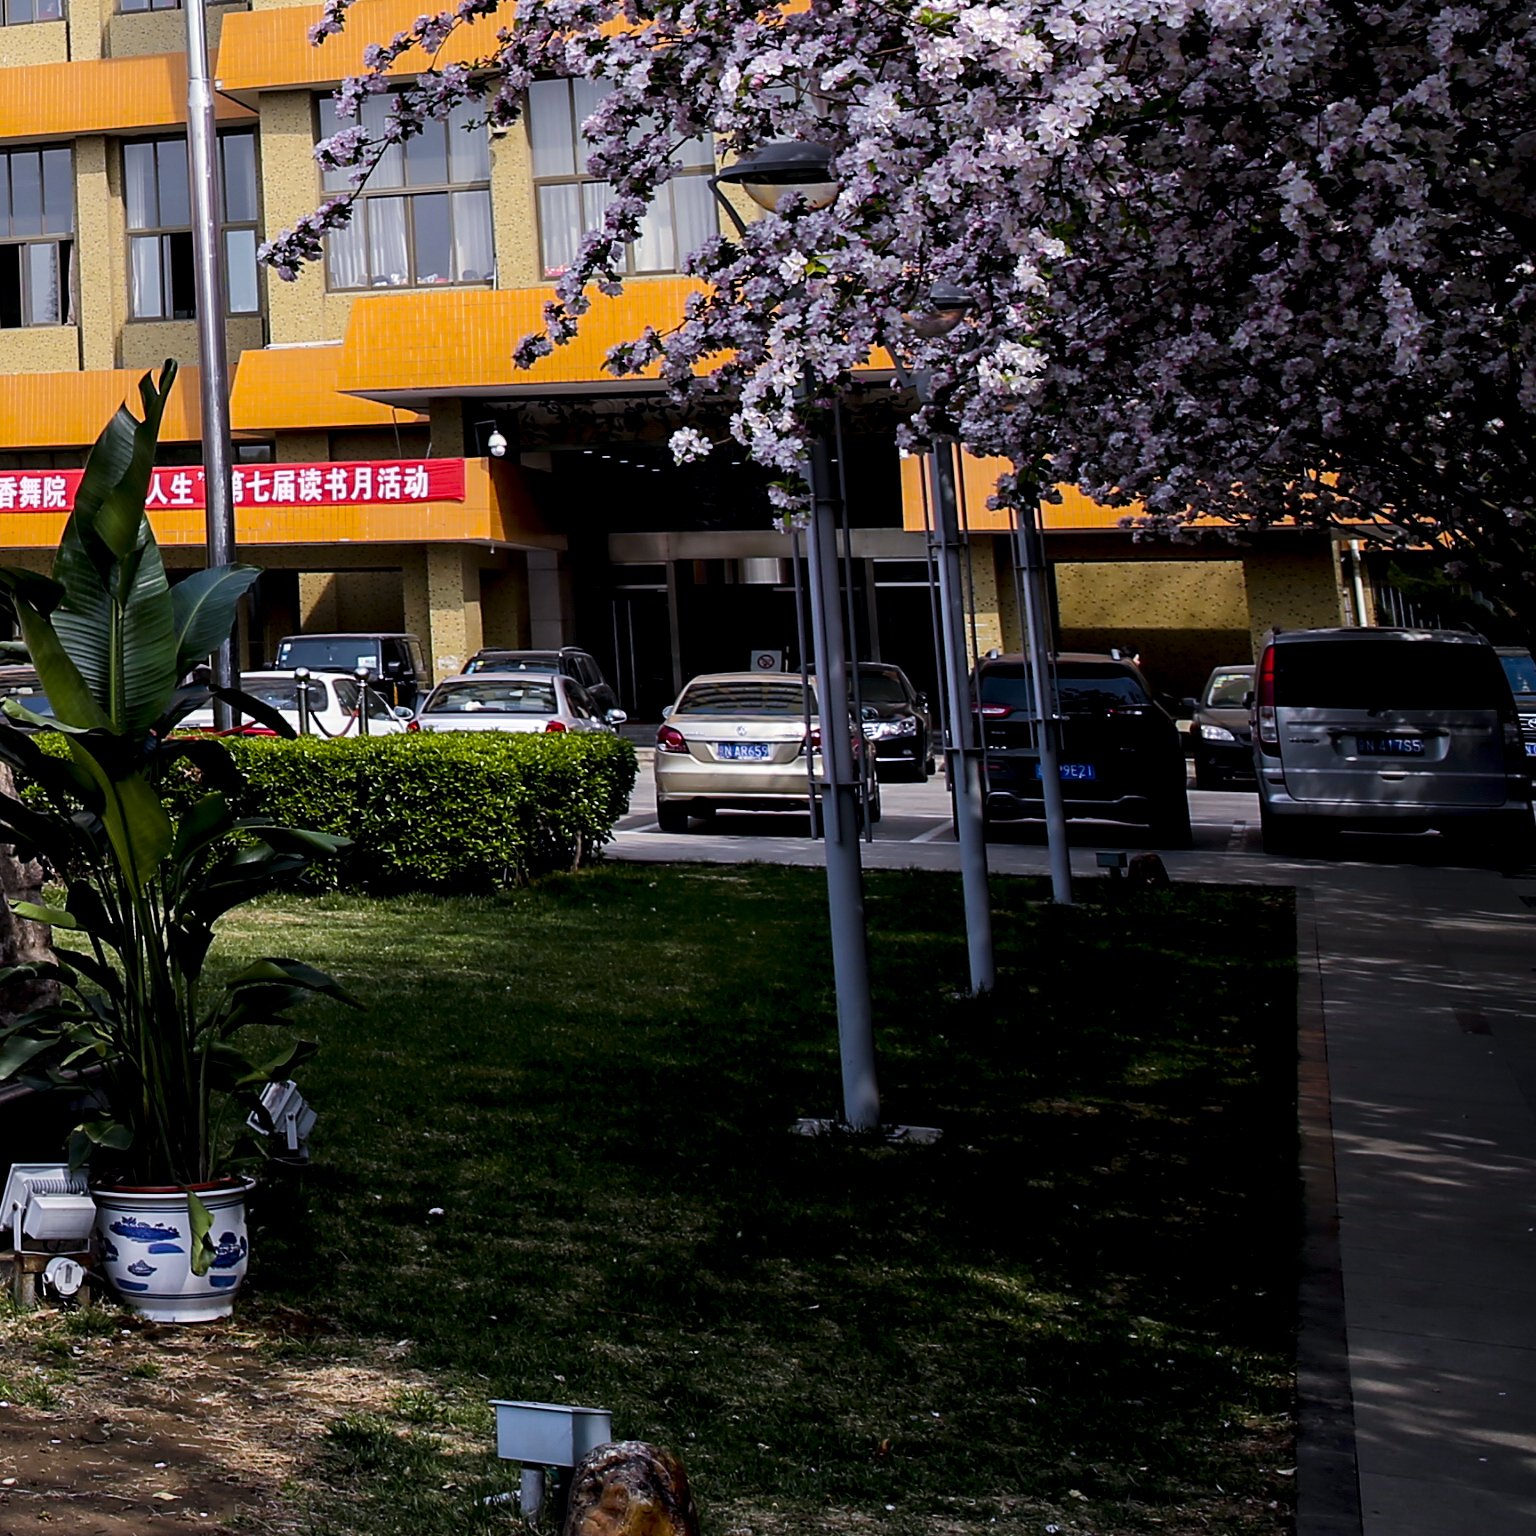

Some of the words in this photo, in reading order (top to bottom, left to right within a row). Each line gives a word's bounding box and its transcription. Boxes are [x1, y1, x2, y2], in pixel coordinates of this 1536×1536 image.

[231, 465, 429, 504] 第七届读书月活动
